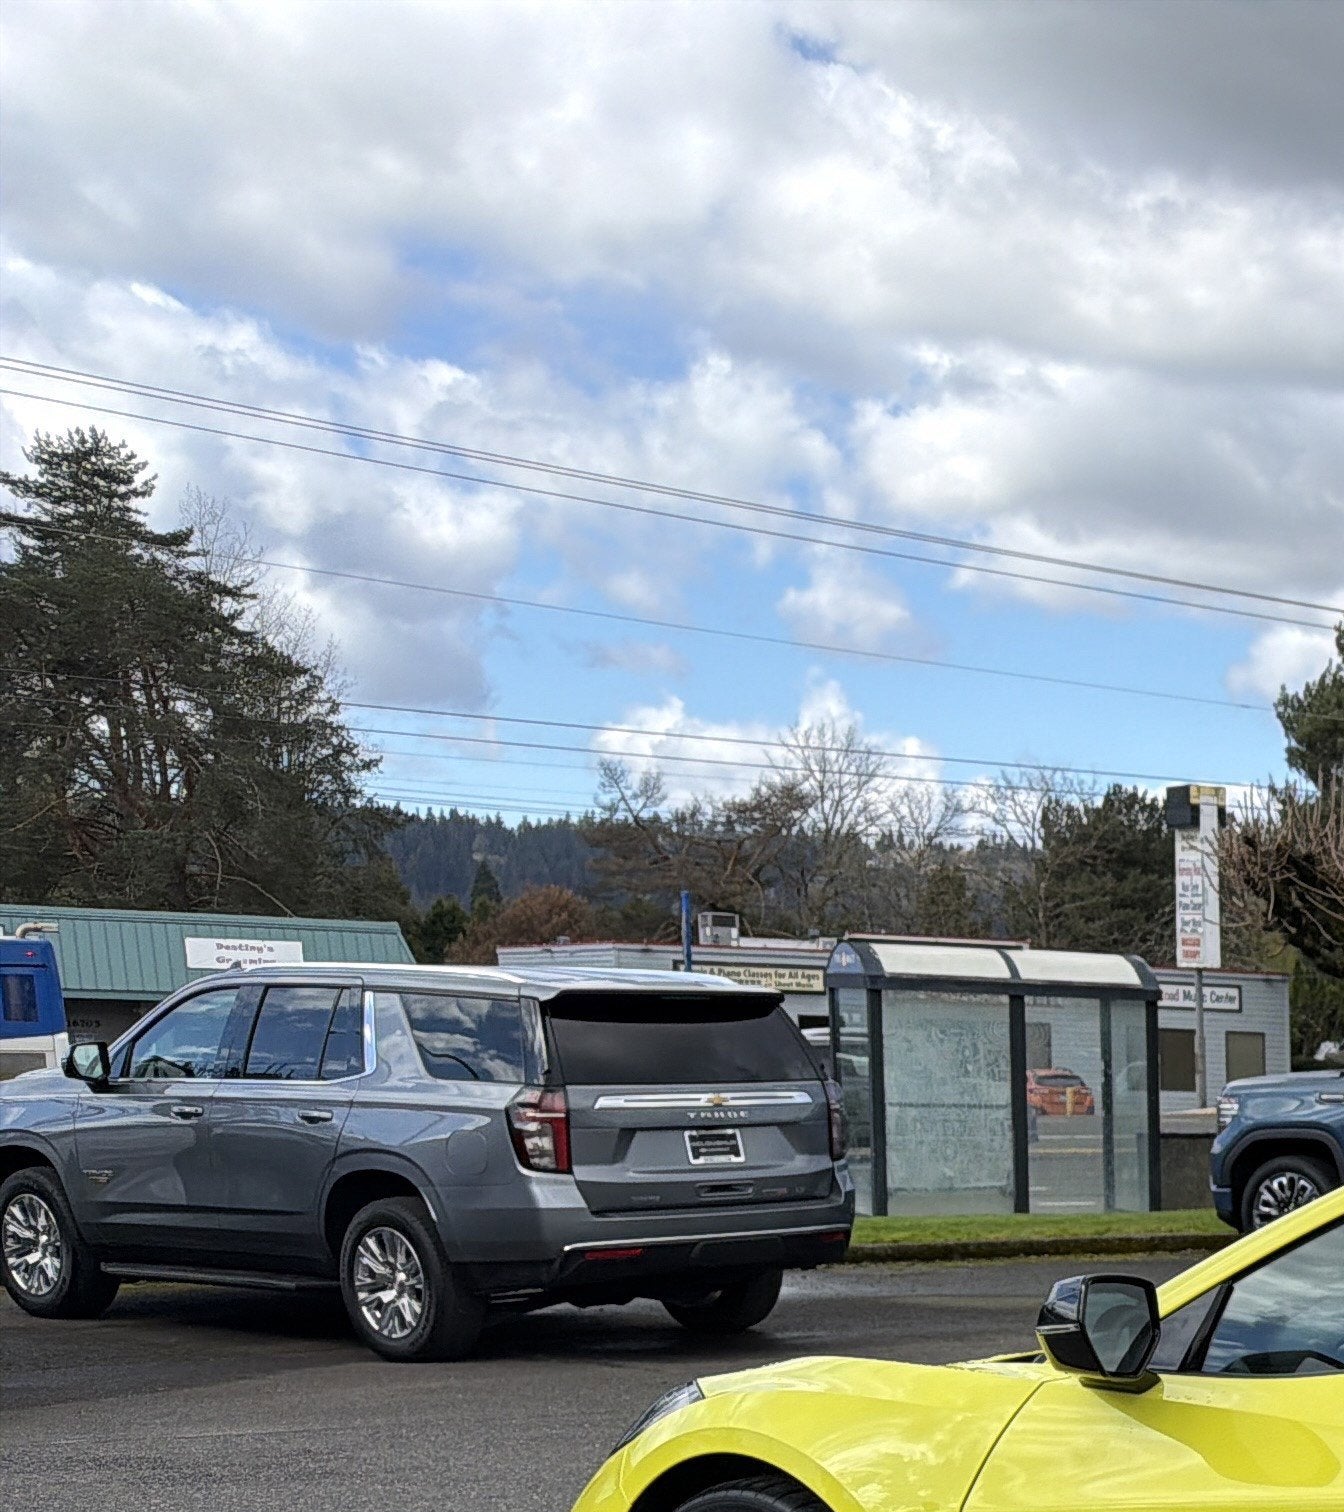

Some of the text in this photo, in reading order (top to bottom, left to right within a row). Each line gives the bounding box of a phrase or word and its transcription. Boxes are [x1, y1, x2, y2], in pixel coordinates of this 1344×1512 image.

[215, 943, 275, 954] Destiny's
[743, 969, 773, 979] Classes
[774, 970, 787, 979] for
[788, 971, 799, 979] All
[801, 971, 820, 982] Ages
[1209, 989, 1237, 1004] Center
